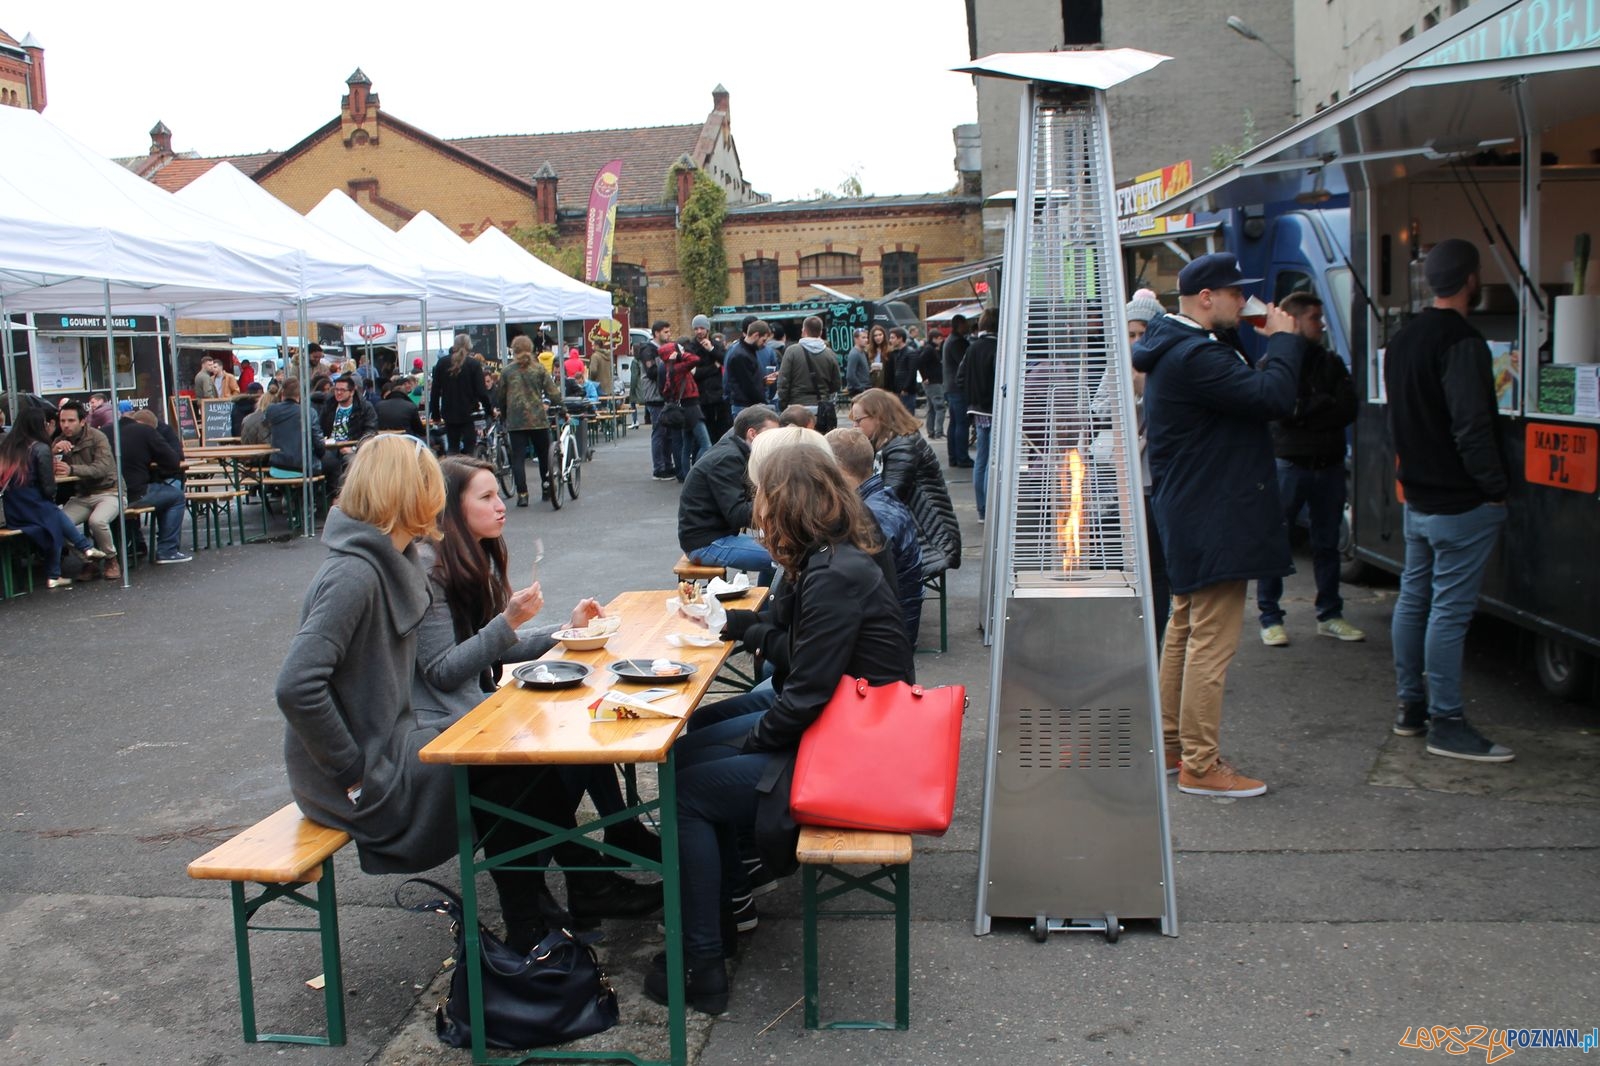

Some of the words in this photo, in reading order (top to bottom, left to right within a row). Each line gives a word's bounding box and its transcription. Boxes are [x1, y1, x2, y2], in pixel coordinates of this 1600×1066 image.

[1115, 177, 1162, 217] FRYTKI
[69, 318, 101, 327] GOURMET
[102, 318, 129, 328] BRGERS
[1534, 430, 1569, 453] MADE
[1573, 435, 1587, 454] IN
[1548, 454, 1569, 483] PL
